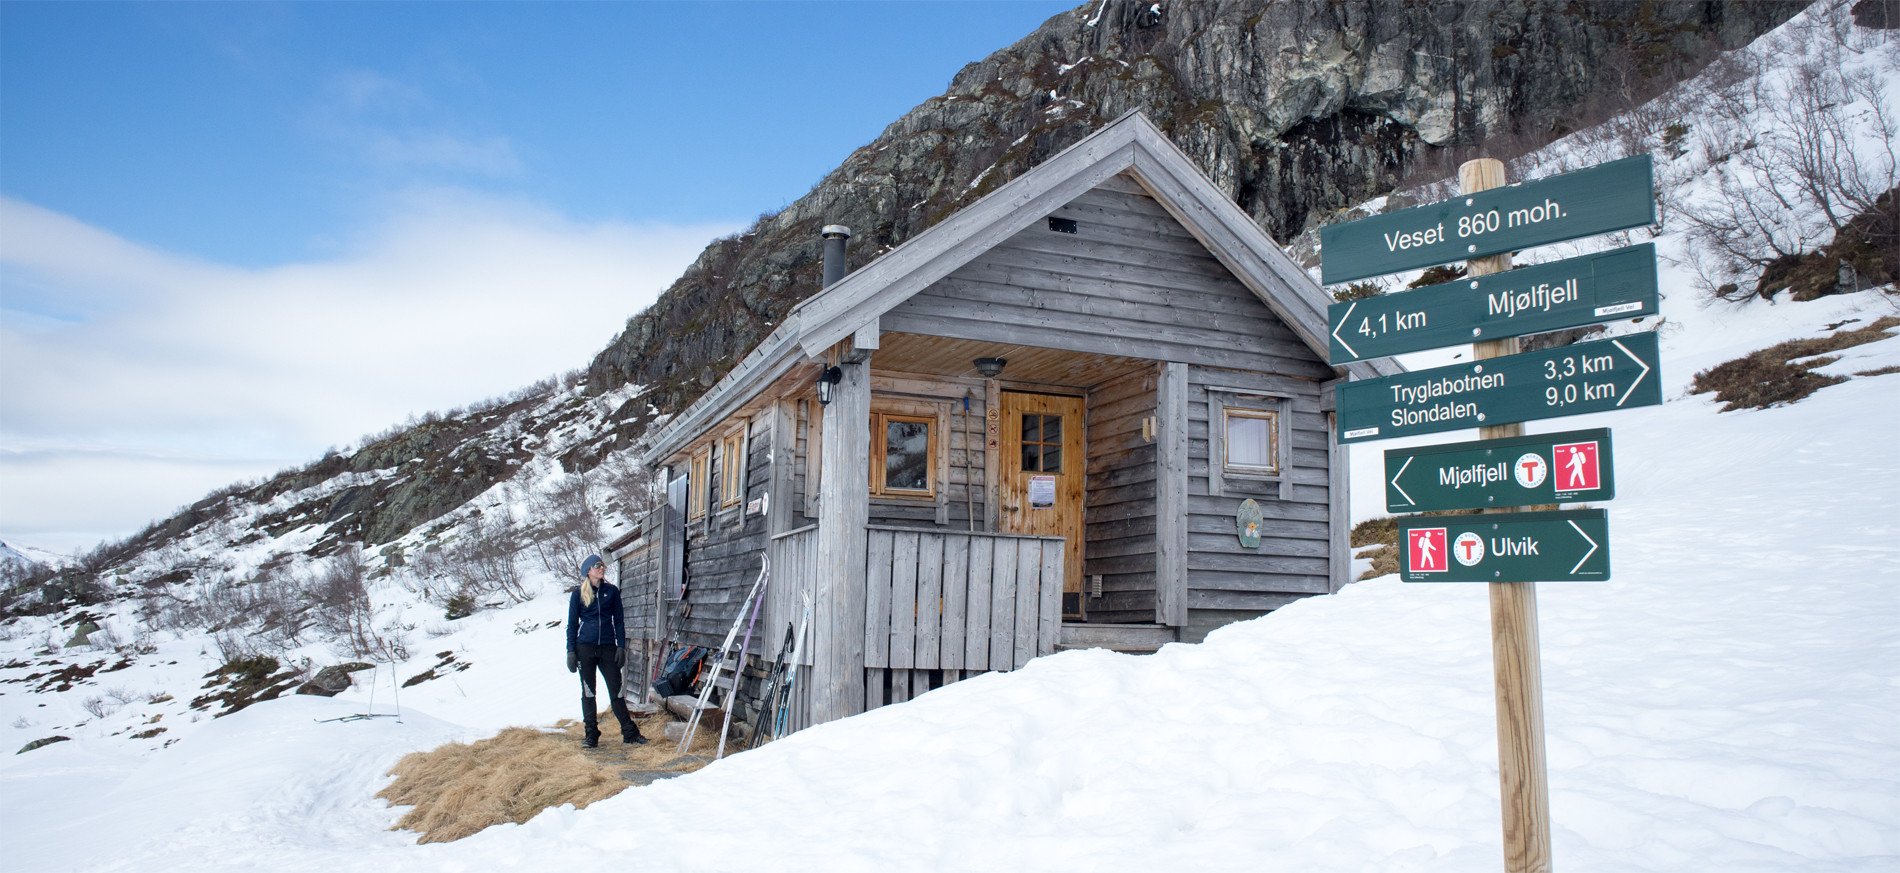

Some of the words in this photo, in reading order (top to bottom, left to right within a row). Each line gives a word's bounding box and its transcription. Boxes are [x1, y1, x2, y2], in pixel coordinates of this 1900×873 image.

[1384, 222, 1445, 252] Veset
[1457, 210, 1500, 238] 860
[1508, 199, 1567, 228] moh.
[1488, 278, 1578, 318] Mjølfjell
[1358, 313, 1387, 339] 4,1
[1396, 310, 1426, 331] km
[1544, 357, 1576, 380] 3,3
[1582, 354, 1613, 374] km
[1390, 373, 1504, 405] Tryglabotnen
[1545, 383, 1577, 407] 9,0
[1584, 381, 1615, 400] km
[1391, 401, 1477, 427] Slondalen
[1439, 462, 1508, 489] Mjølfjell
[1521, 461, 1539, 482] T
[1460, 540, 1477, 560] T
[1491, 536, 1539, 557] Ulvik
